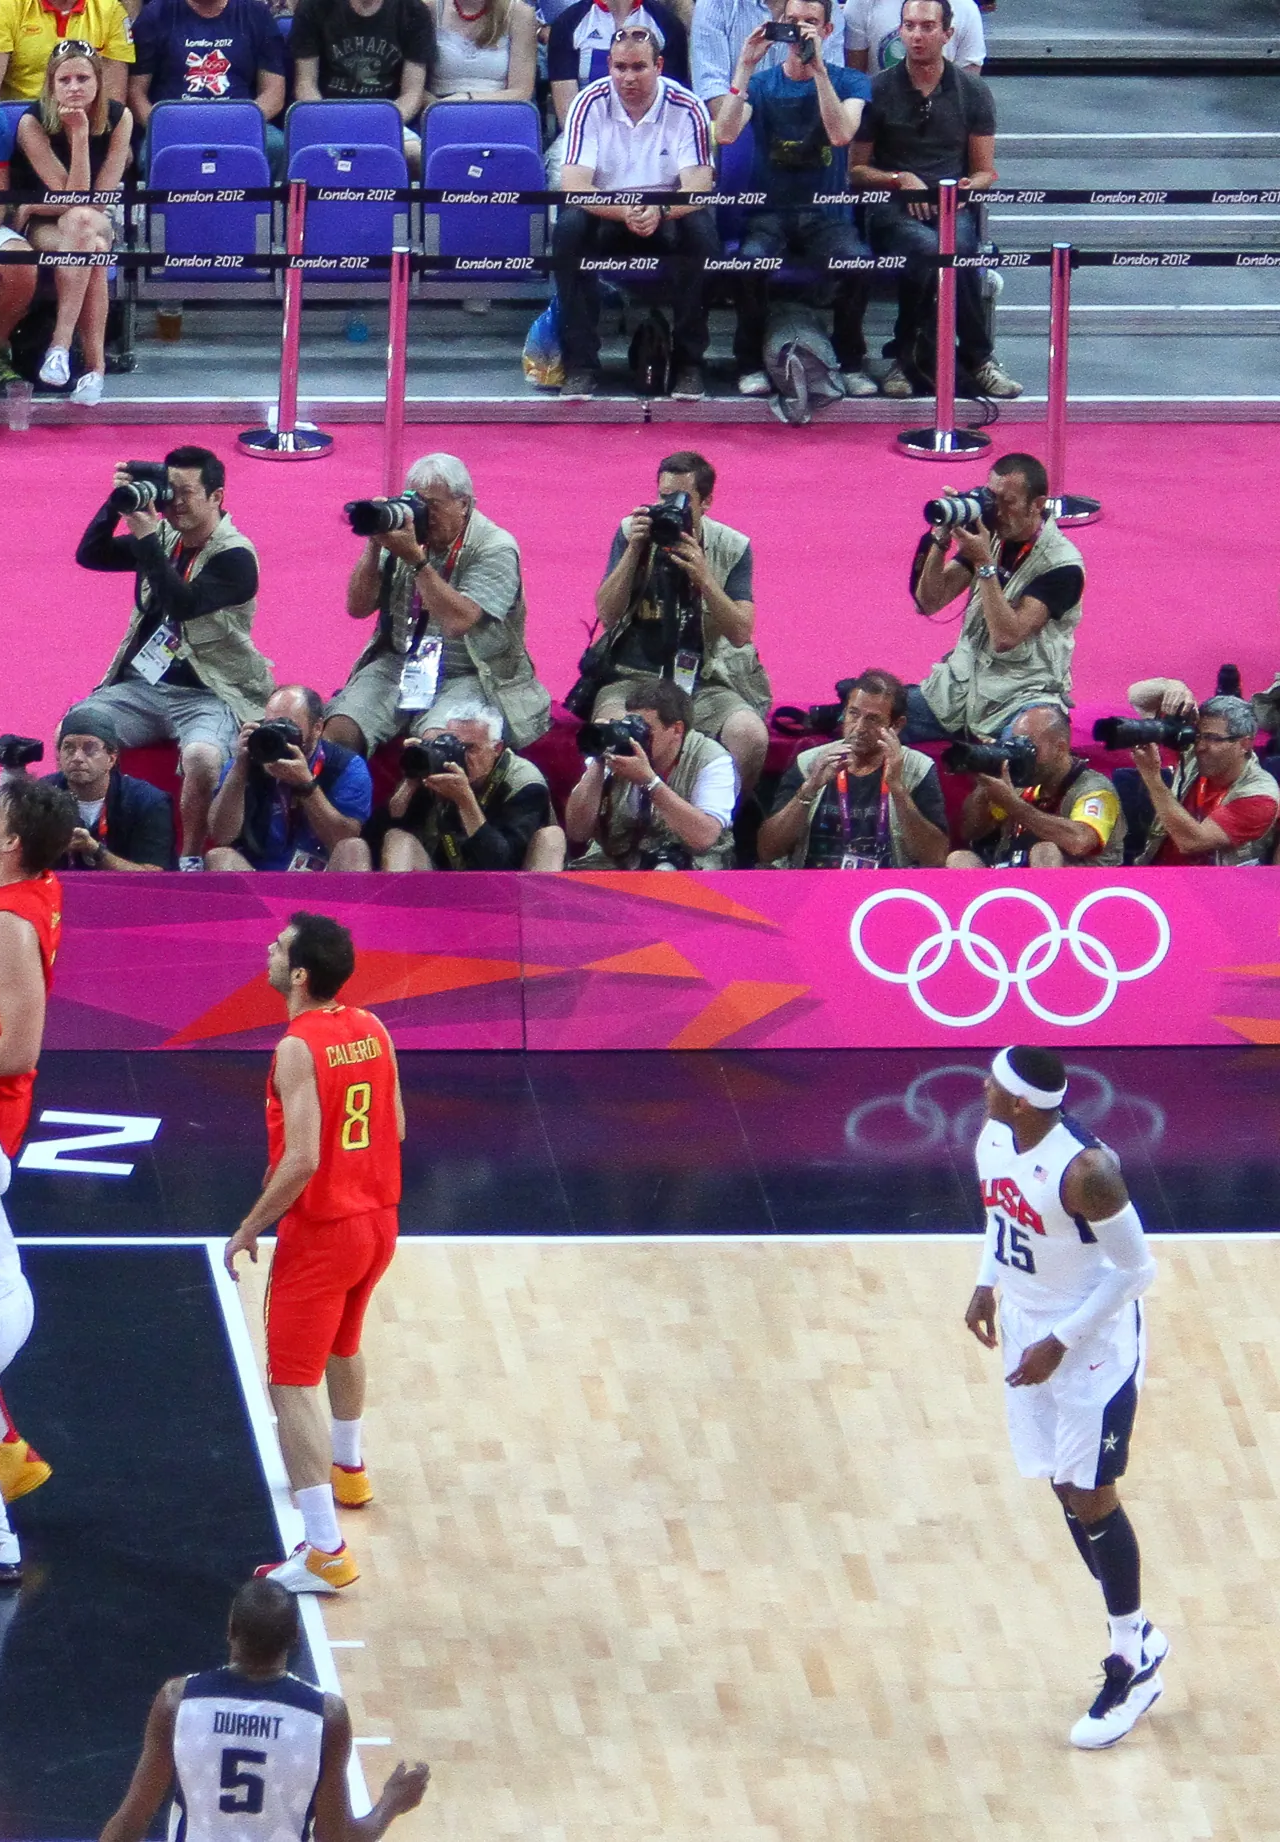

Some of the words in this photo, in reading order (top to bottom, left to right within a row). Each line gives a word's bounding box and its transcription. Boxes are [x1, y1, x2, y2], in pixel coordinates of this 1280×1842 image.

[214, 38, 233, 47] 2012
[44, 192, 89, 204] London
[93, 192, 121, 203] 2012
[167, 191, 213, 203] London
[217, 190, 245, 201] 2012
[318, 188, 364, 200] London
[366, 189, 396, 201] 2012
[442, 191, 488, 204] London
[491, 192, 520, 204] 2012
[565, 193, 611, 205] London
[614, 193, 643, 204] 2012
[689, 193, 735, 205] London
[738, 193, 767, 205] 2012
[813, 191, 858, 204] London
[862, 191, 891, 203] 2012
[968, 190, 1014, 202] London
[1017, 191, 1046, 202] 2012
[1090, 191, 1136, 203] London
[1139, 191, 1167, 203] 2012
[1212, 191, 1258, 203] London
[1261, 191, 1280, 202] 201
[39, 253, 85, 265] London
[89, 254, 118, 266] 2012
[165, 255, 211, 267] London
[214, 256, 244, 268] 2012
[290, 256, 337, 268] London
[340, 257, 369, 268] 2012
[455, 257, 502, 269] London
[505, 257, 534, 269] 2012
[580, 257, 626, 270] London
[629, 258, 658, 270] 2012
[704, 257, 750, 270] London
[753, 257, 783, 269] 2012
[828, 257, 874, 269] London
[877, 256, 906, 268] 2012
[953, 255, 998, 267] London
[1001, 254, 1031, 266] 2012
[1112, 254, 1159, 266] London
[1162, 254, 1190, 266] 2012
[342, 1082, 372, 1151] 8
[980, 1178, 1046, 1236] USA
[994, 1213, 1036, 1274] 15
[213, 1711, 283, 1740] DURANT
[220, 1747, 267, 1814] 5
